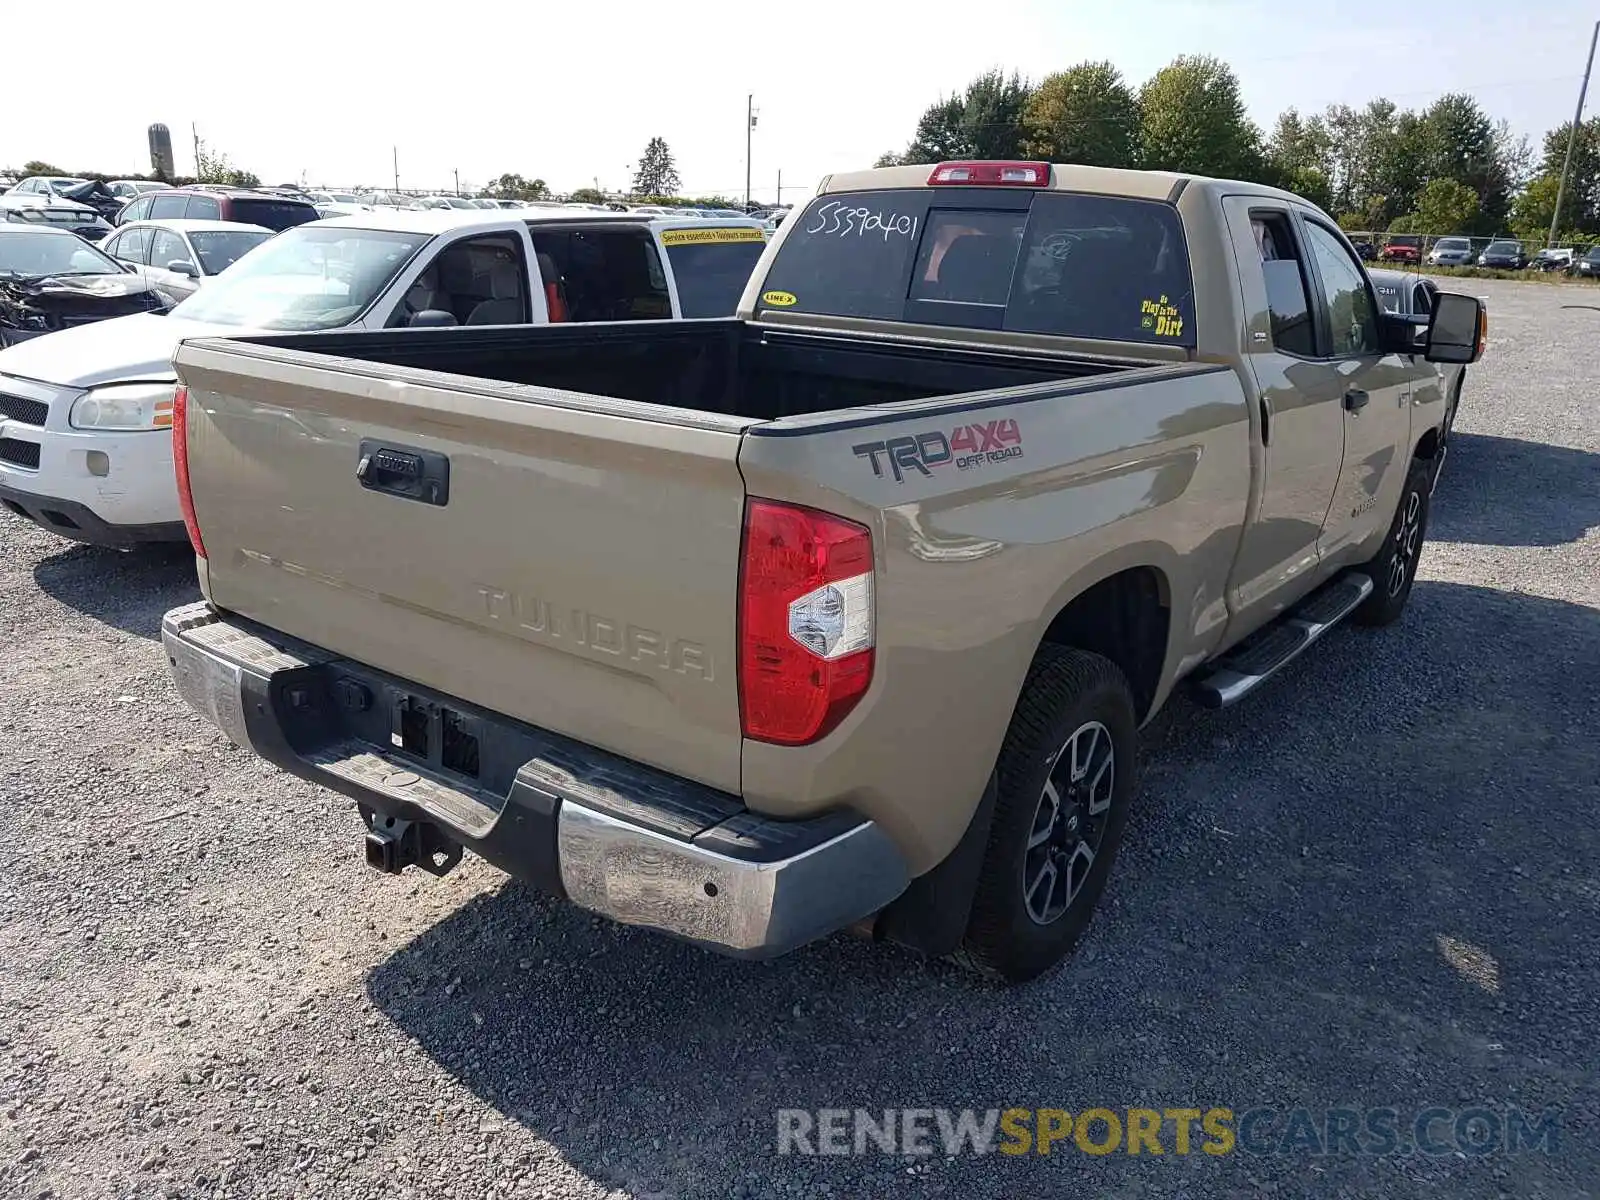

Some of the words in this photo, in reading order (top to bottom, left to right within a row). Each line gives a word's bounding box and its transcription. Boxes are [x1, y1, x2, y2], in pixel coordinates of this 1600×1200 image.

[1142, 300, 1160, 316] Play
[1155, 315, 1183, 337] Dirt
[377, 454, 416, 472] TOYOTA
[852, 431, 953, 483] TRD
[955, 454, 984, 470] OFF
[986, 446, 1023, 463] ROAD
[476, 584, 715, 682] TUNDRA
